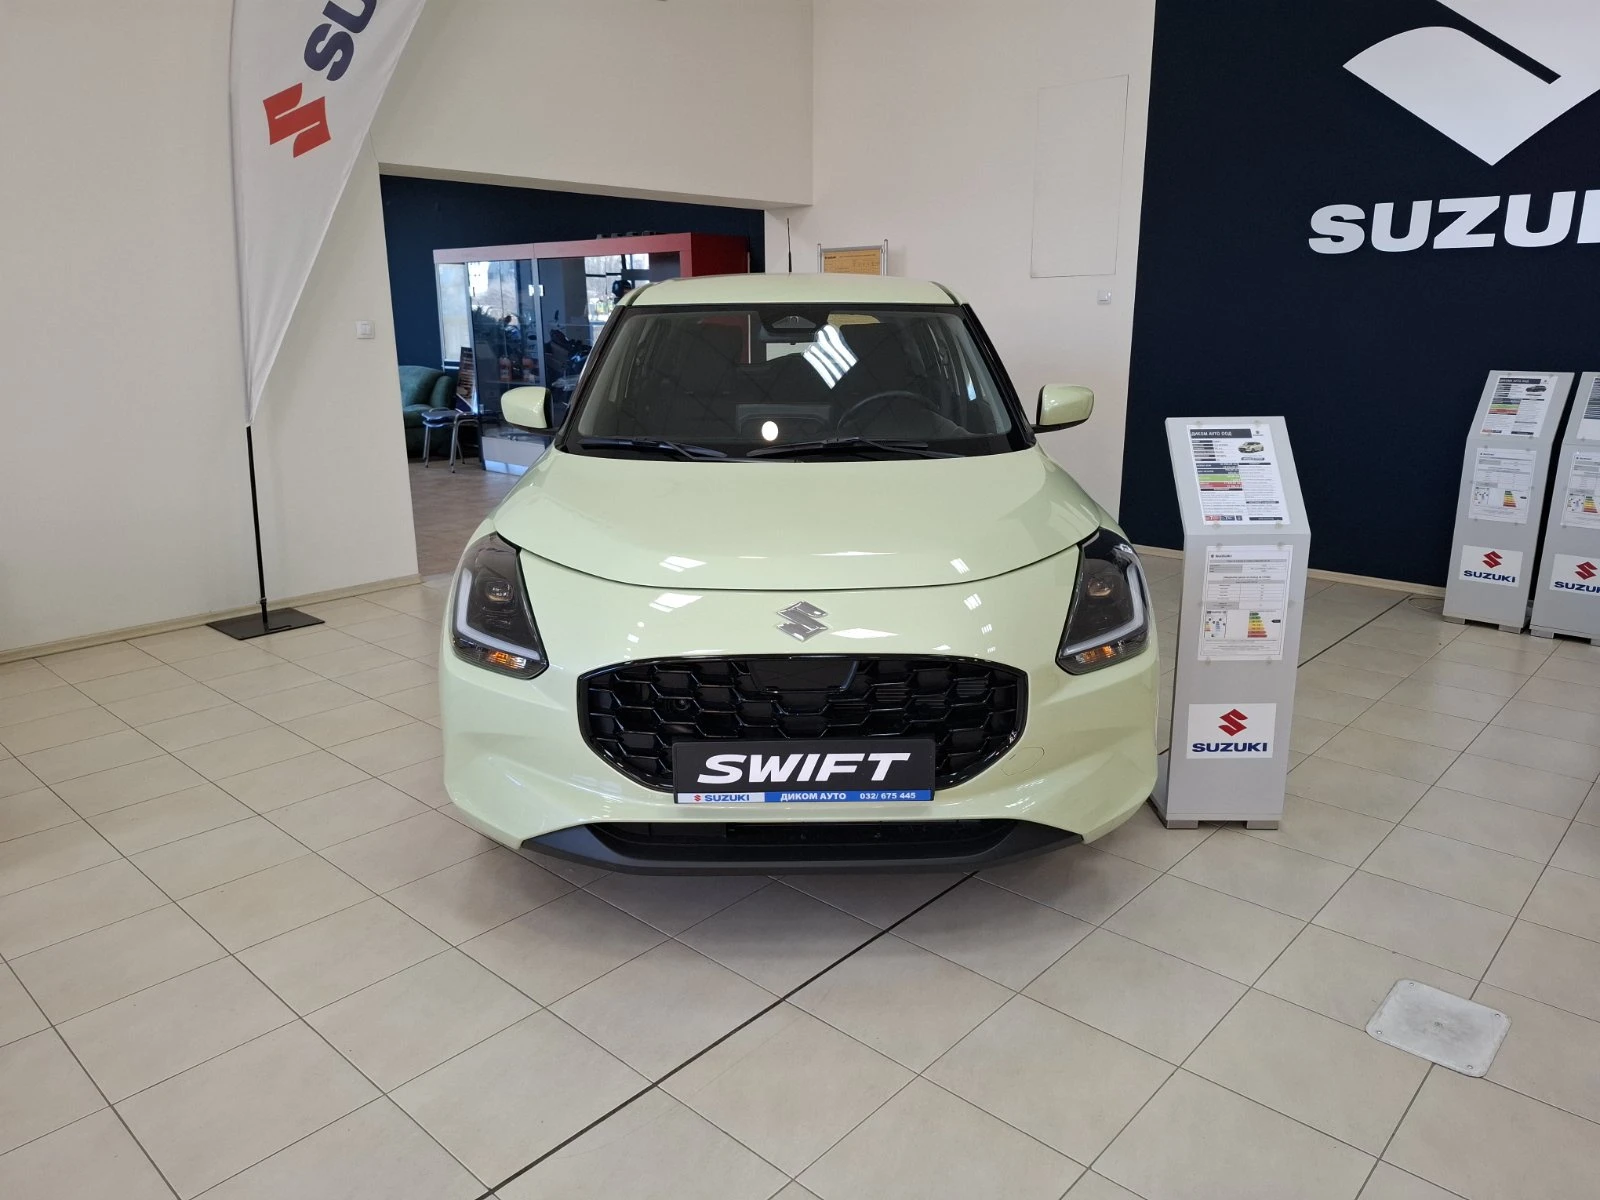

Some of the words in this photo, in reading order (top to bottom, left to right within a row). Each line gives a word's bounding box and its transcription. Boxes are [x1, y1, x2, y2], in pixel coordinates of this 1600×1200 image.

[1463, 569, 1516, 583] SUZUKI
[1191, 742, 1268, 752] SUZUKI
[697, 752, 911, 785] SWIFT
[704, 794, 749, 802] SUZUKI
[780, 793, 818, 801] ДИКОМ
[819, 792, 846, 800] АУТО
[860, 792, 879, 800] 032/
[880, 792, 898, 800] 675
[899, 791, 917, 800] 445
